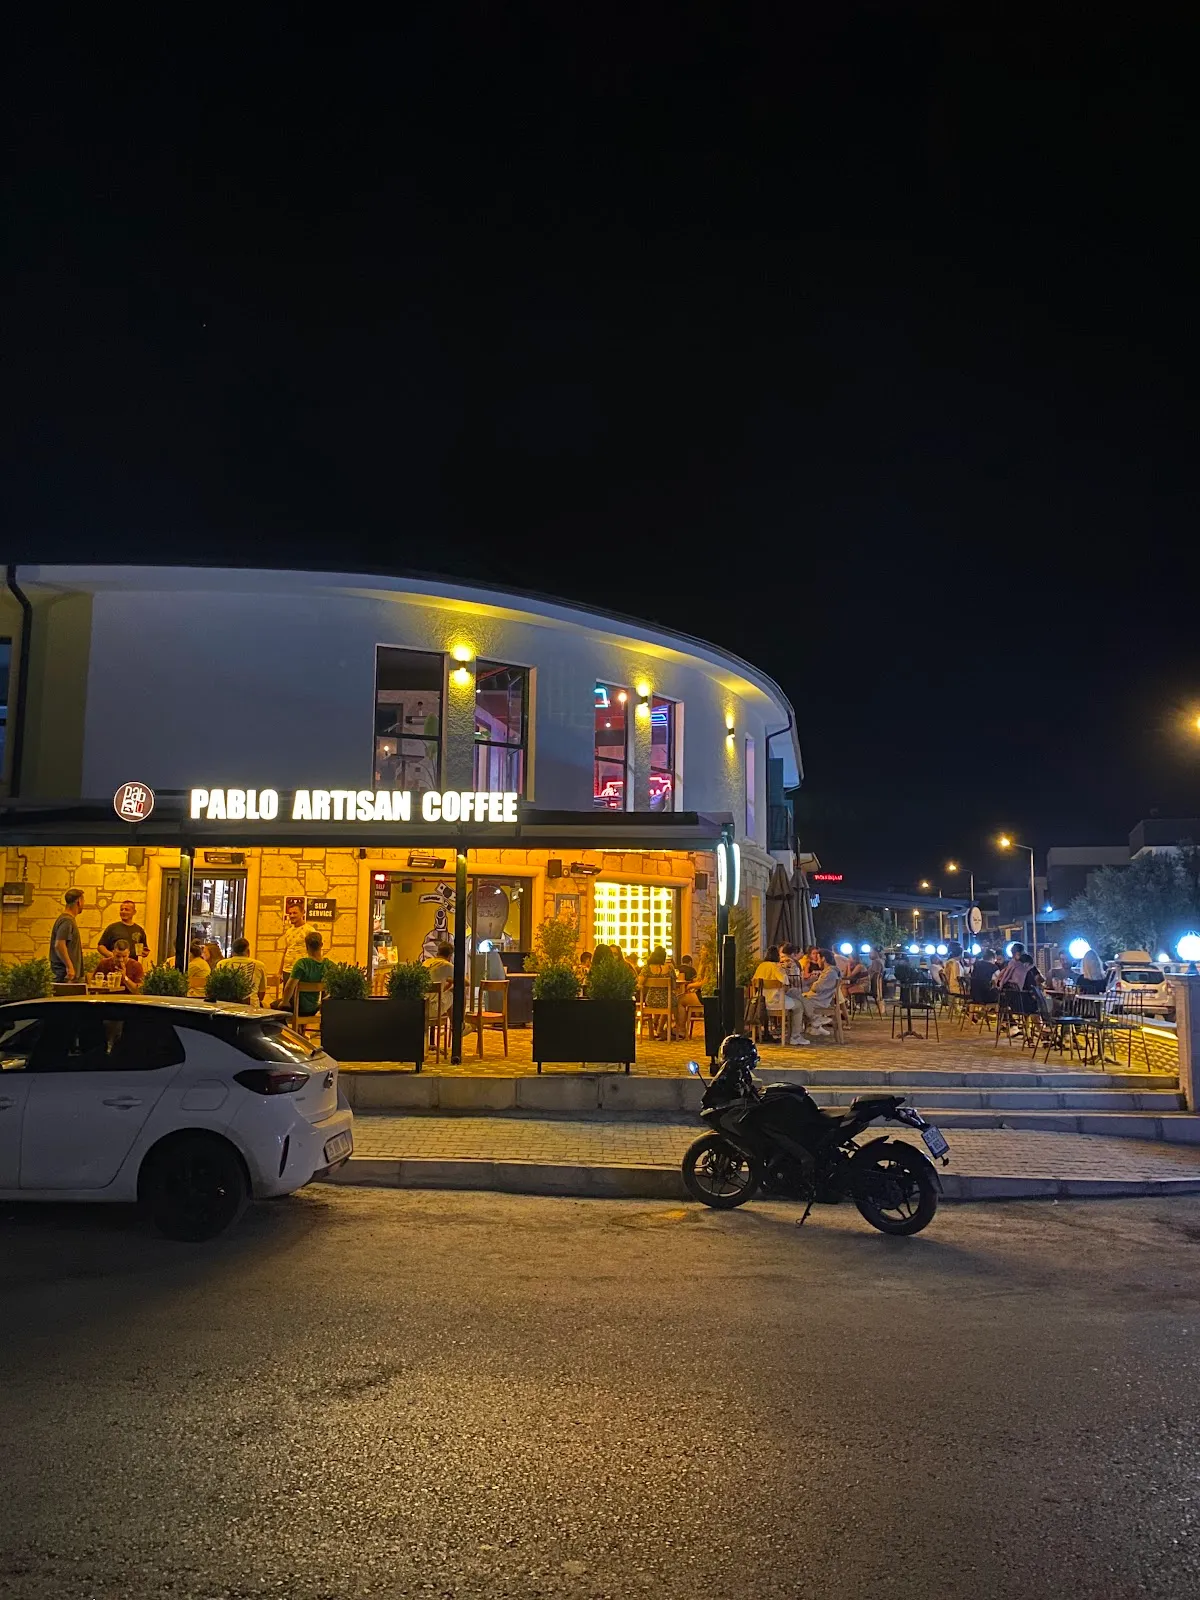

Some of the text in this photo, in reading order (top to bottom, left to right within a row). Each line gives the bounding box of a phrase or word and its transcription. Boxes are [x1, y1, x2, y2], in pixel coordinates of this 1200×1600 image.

[190, 788, 518, 822] PABLO ARTISAN COFFEE
